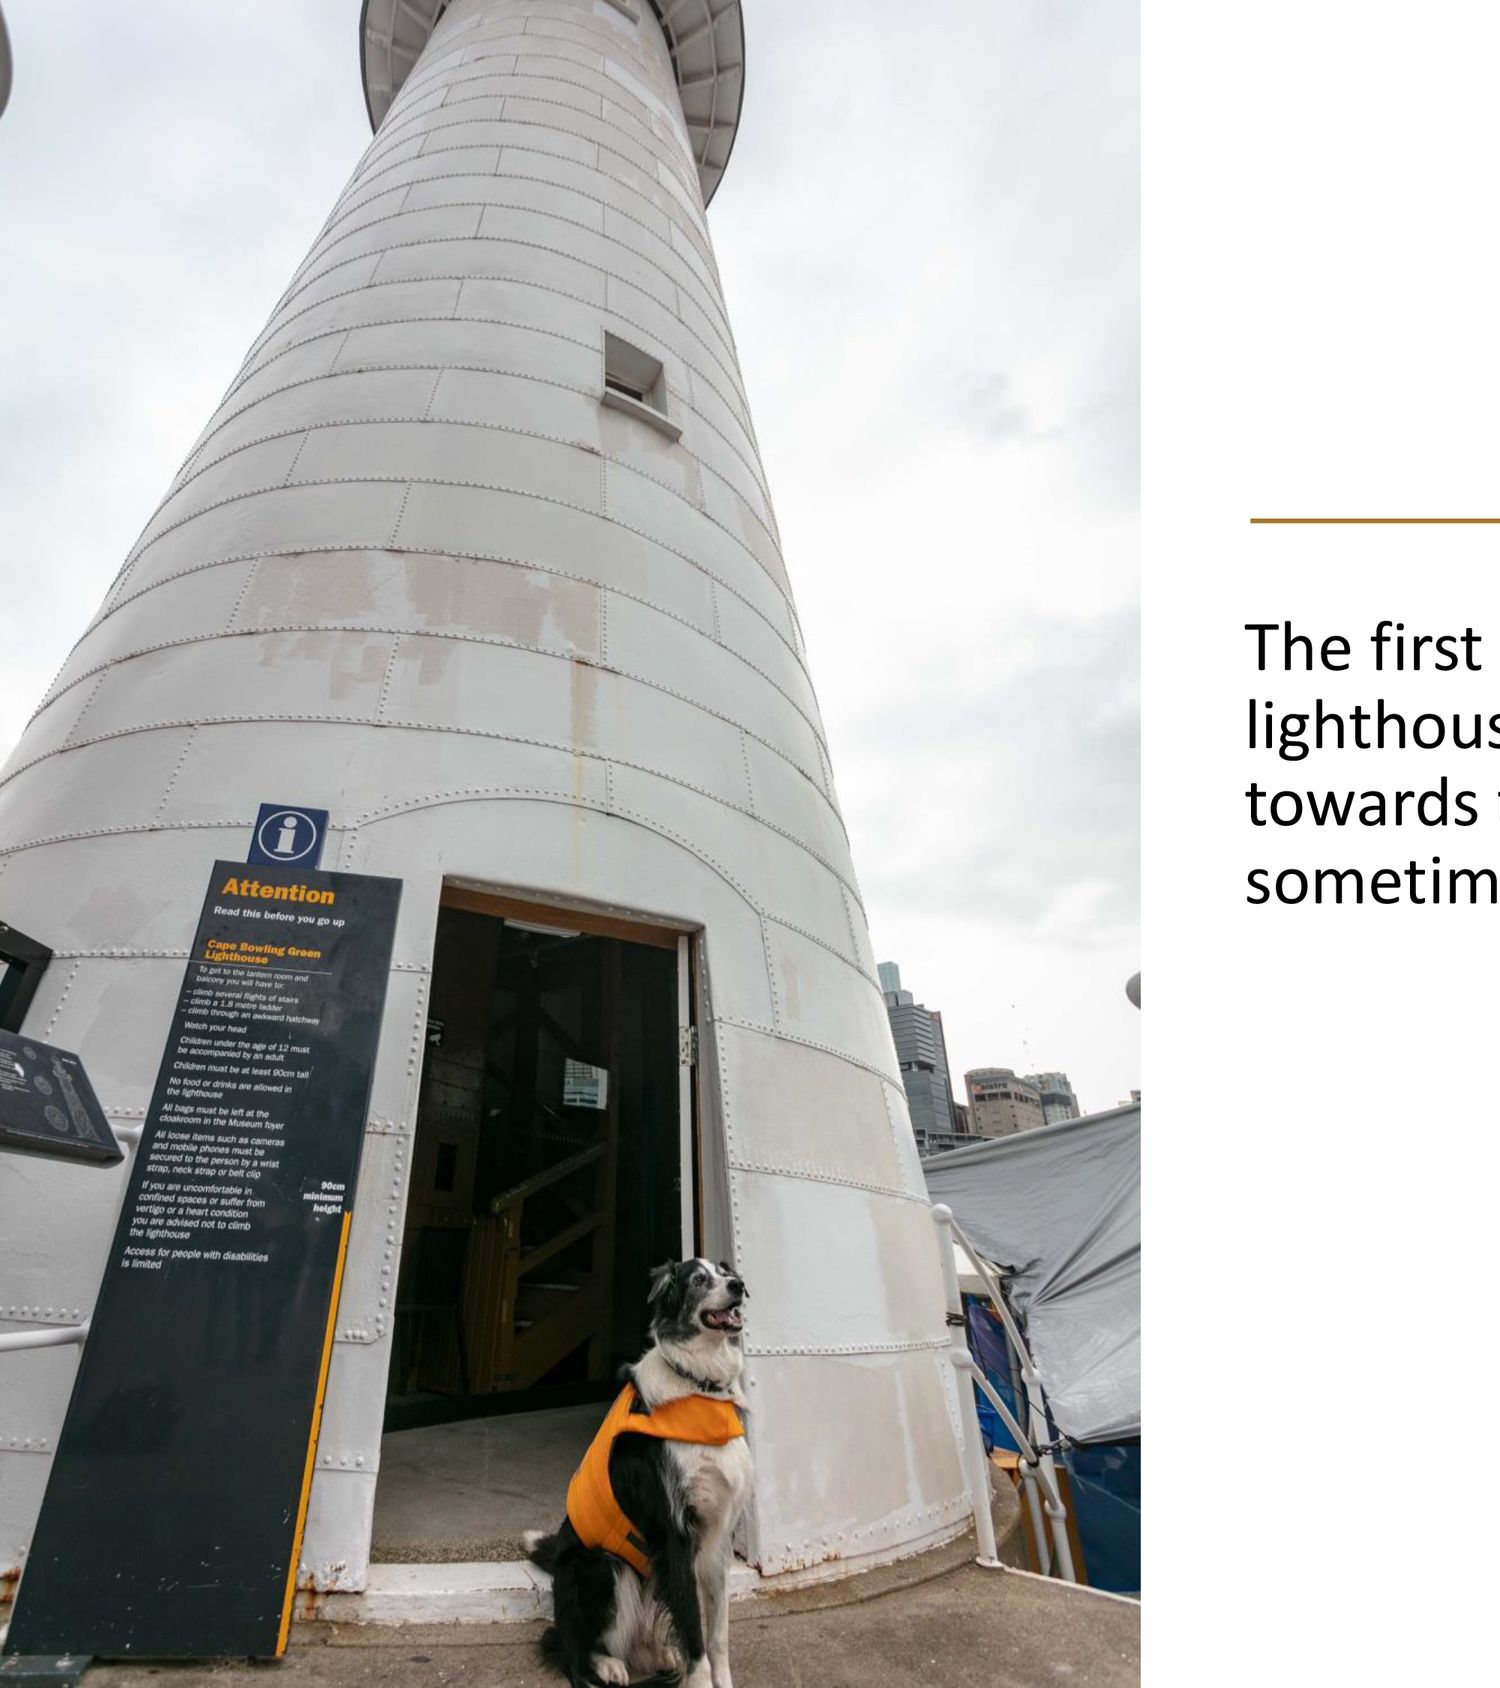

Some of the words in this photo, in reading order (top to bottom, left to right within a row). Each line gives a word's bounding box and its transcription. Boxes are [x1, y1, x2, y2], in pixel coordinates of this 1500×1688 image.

[222, 877, 335, 905] Attention
[213, 905, 241, 917] Read
[242, 908, 261, 919] this
[263, 910, 296, 922] before
[296, 915, 316, 924] you
[316, 917, 331, 927] go
[332, 919, 346, 928] up
[204, 949, 269, 964] Lighthouse
[207, 939, 237, 951] Cape
[239, 942, 286, 957] Bowling
[287, 946, 321, 959] Green
[196, 975, 225, 986] balcony
[225, 978, 240, 986] you
[241, 979, 255, 987] will
[254, 980, 273, 989] have
[208, 967, 222, 975] get
[246, 970, 273, 979] lantern
[273, 973, 293, 981] room
[192, 988, 214, 997] climb
[214, 990, 243, 999] several
[243, 992, 267, 1002] flights
[277, 996, 299, 1004] stairs
[190, 997, 212, 1006] climb
[220, 999, 234, 1008] 1.8
[234, 1002, 258, 1010] metre
[258, 1003, 283, 1012] ladder
[187, 1007, 209, 1016] climb
[210, 1008, 240, 1019] through
[252, 1013, 285, 1022] awkward
[285, 1014, 321, 1026] hatchway
[184, 1021, 208, 1030] Watch
[208, 1024, 227, 1033] your
[227, 1024, 248, 1034] head
[179, 1035, 213, 1046] Children
[213, 1039, 237, 1048] under
[237, 1040, 251, 1050] the
[251, 1043, 267, 1052] age
[278, 1043, 290, 1052] 12
[289, 1046, 311, 1054] must
[177, 1045, 189, 1054] be
[189, 1047, 242, 1059] accompanied
[241, 1051, 252, 1061] by
[264, 1053, 285, 1062] adult
[173, 1060, 207, 1071] Children
[207, 1065, 229, 1073] must
[251, 1067, 272, 1076] least
[272, 1068, 295, 1078] 90cm
[296, 1071, 310, 1079] tall
[169, 1076, 182, 1085] No
[182, 1077, 202, 1087] food
[212, 1080, 237, 1090] drinks
[238, 1083, 252, 1091] are
[253, 1083, 284, 1093] allowed
[166, 1087, 181, 1096] the
[181, 1088, 224, 1099] lighthouse
[161, 1102, 174, 1112] All
[174, 1104, 195, 1115] bags
[195, 1106, 218, 1115] must
[218, 1107, 230, 1116] be
[230, 1108, 245, 1117] left
[256, 1110, 270, 1119] the
[159, 1113, 202, 1125] cloakroom
[213, 1117, 227, 1127] the
[227, 1118, 263, 1129] Museum
[264, 1120, 285, 1131] foyer
[154, 1130, 167, 1139] All
[167, 1131, 191, 1141] loose
[191, 1132, 216, 1143] items
[216, 1135, 237, 1143] such
[250, 1137, 285, 1147] cameras
[152, 1142, 170, 1151] and
[169, 1143, 198, 1152] mobile
[198, 1144, 230, 1154] phones
[231, 1147, 253, 1156] must
[254, 1147, 265, 1157] be
[149, 1153, 184, 1163] secured
[195, 1155, 210, 1164] the
[210, 1157, 240, 1166] person
[240, 1158, 252, 1168] by
[259, 1160, 280, 1169] wrist
[146, 1164, 171, 1174] strap,
[172, 1165, 193, 1175] neck
[194, 1167, 217, 1177] strap
[228, 1168, 245, 1178] belt
[245, 1169, 261, 1180] clip
[148, 1182, 166, 1191] you
[166, 1183, 182, 1192] are
[182, 1184, 243, 1195] uncomfortable
[321, 1181, 346, 1191] 90cm
[138, 1192, 176, 1203] confined
[176, 1195, 208, 1205] spaces
[220, 1197, 245, 1207] suffer
[246, 1198, 266, 1208] from
[302, 1192, 344, 1202] minimum
[135, 1204, 166, 1216] vertigo
[185, 1206, 209, 1217] heart
[209, 1209, 249, 1219] condition
[312, 1203, 342, 1215] height
[131, 1216, 149, 1226] you
[149, 1217, 165, 1226] are
[165, 1217, 200, 1228] advised
[200, 1220, 216, 1229] not
[217, 1220, 227, 1230] to
[227, 1220, 251, 1231] climb
[129, 1227, 145, 1237] the
[145, 1228, 191, 1240] lighthouse
[123, 1245, 157, 1257] Access
[157, 1247, 171, 1257] for
[171, 1249, 202, 1260] people
[203, 1250, 222, 1260] with
[222, 1251, 269, 1263] disabilities
[131, 1258, 163, 1270] limited
